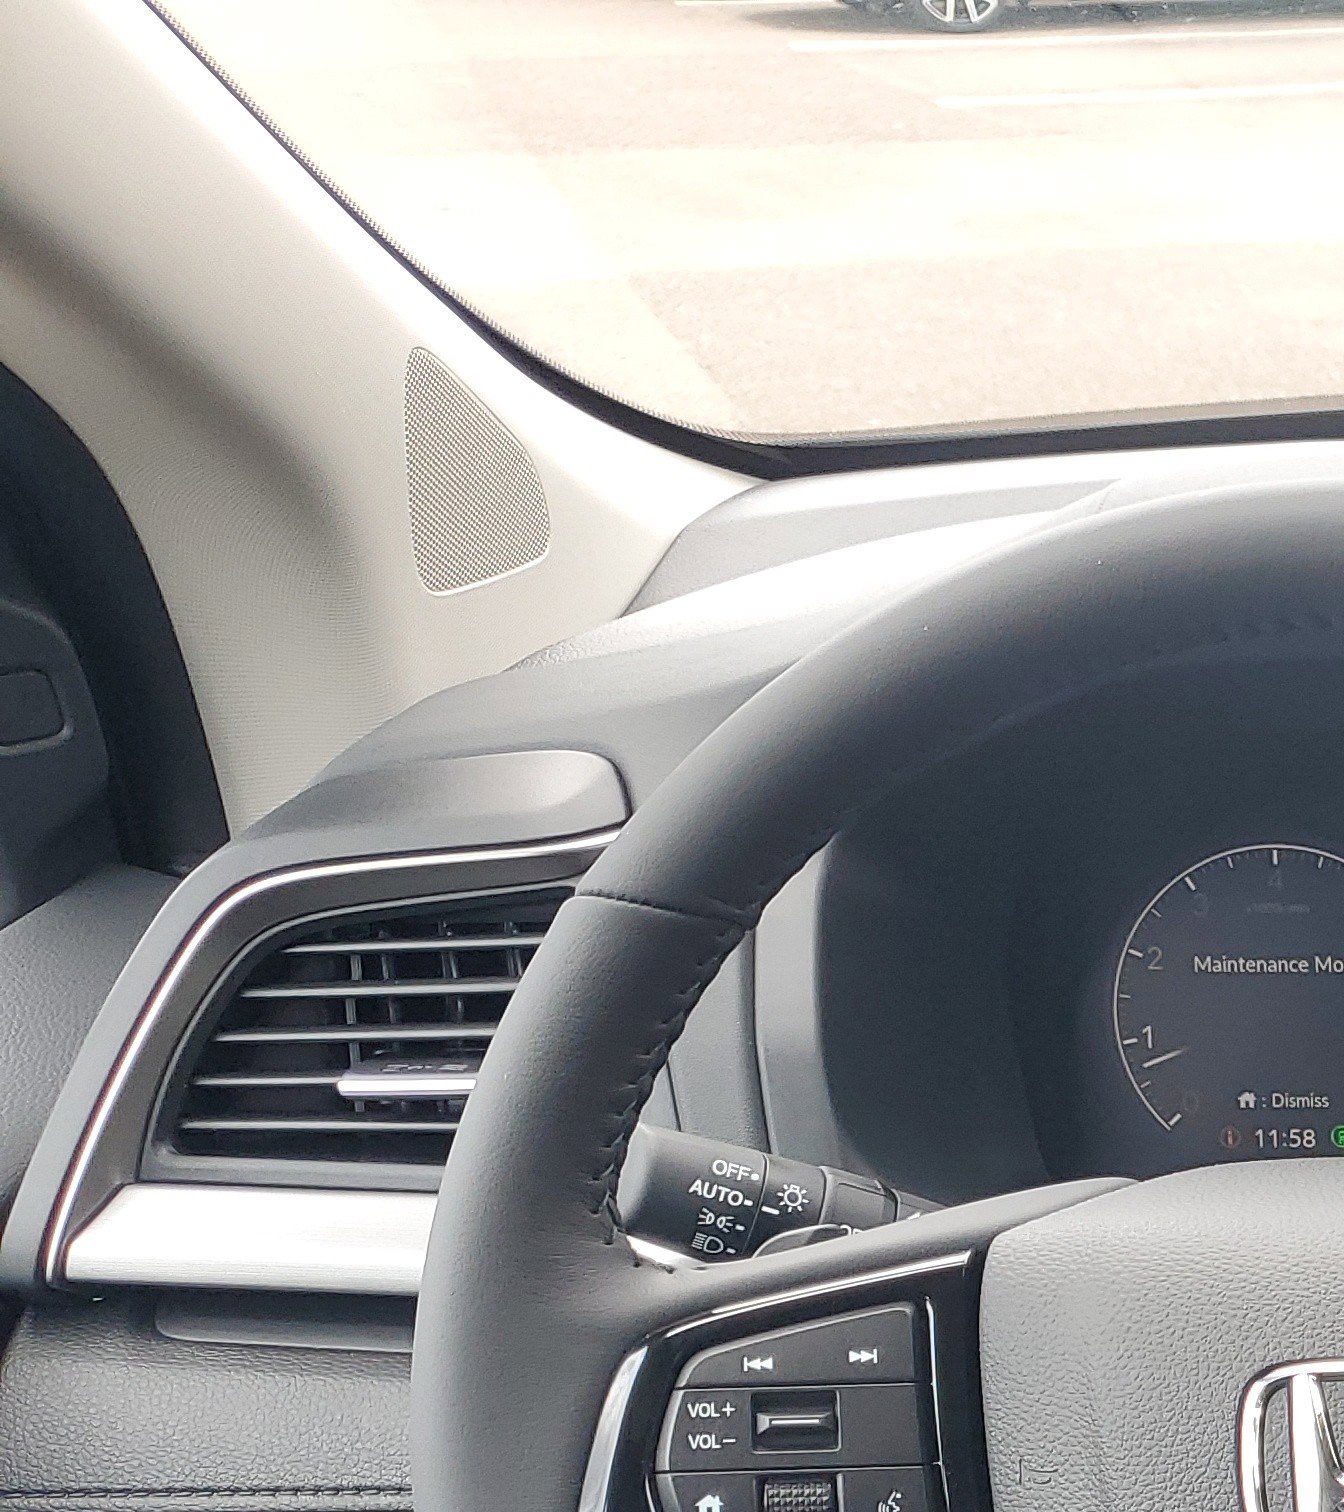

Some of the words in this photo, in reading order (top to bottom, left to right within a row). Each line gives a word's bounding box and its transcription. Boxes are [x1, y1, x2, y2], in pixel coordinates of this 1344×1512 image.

[1146, 946, 1163, 971] 2
[1193, 955, 1309, 974] Maintenance
[1142, 1025, 1153, 1049] 1
[1271, 1093, 1330, 1109] Dismiss
[1254, 1128, 1317, 1149] 11:58
[712, 1159, 752, 1181] OFF
[687, 1178, 744, 1207] AUTO
[687, 1400, 736, 1419] VOL+
[687, 1432, 737, 1450] VOL-
